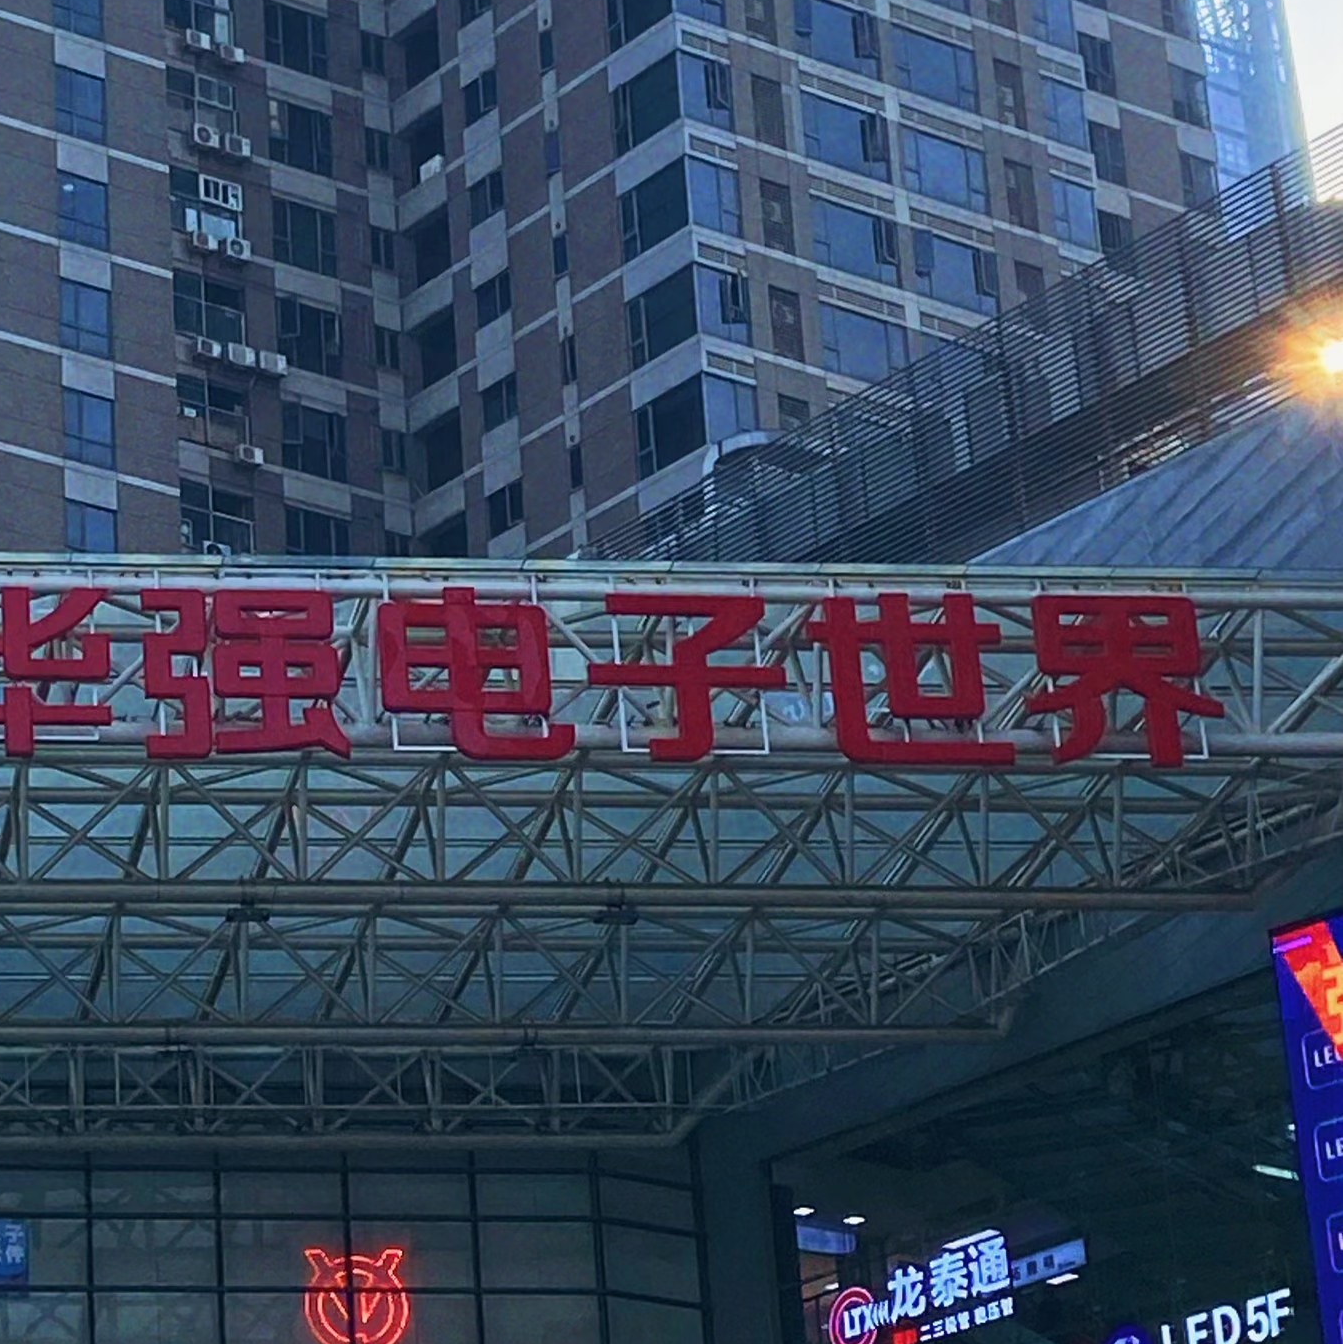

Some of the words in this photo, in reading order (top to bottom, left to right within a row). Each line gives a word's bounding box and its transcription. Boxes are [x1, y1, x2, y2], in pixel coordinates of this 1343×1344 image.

[887, 1235, 1011, 1323] 龙泰通
[1245, 1287, 1291, 1344] 5F
